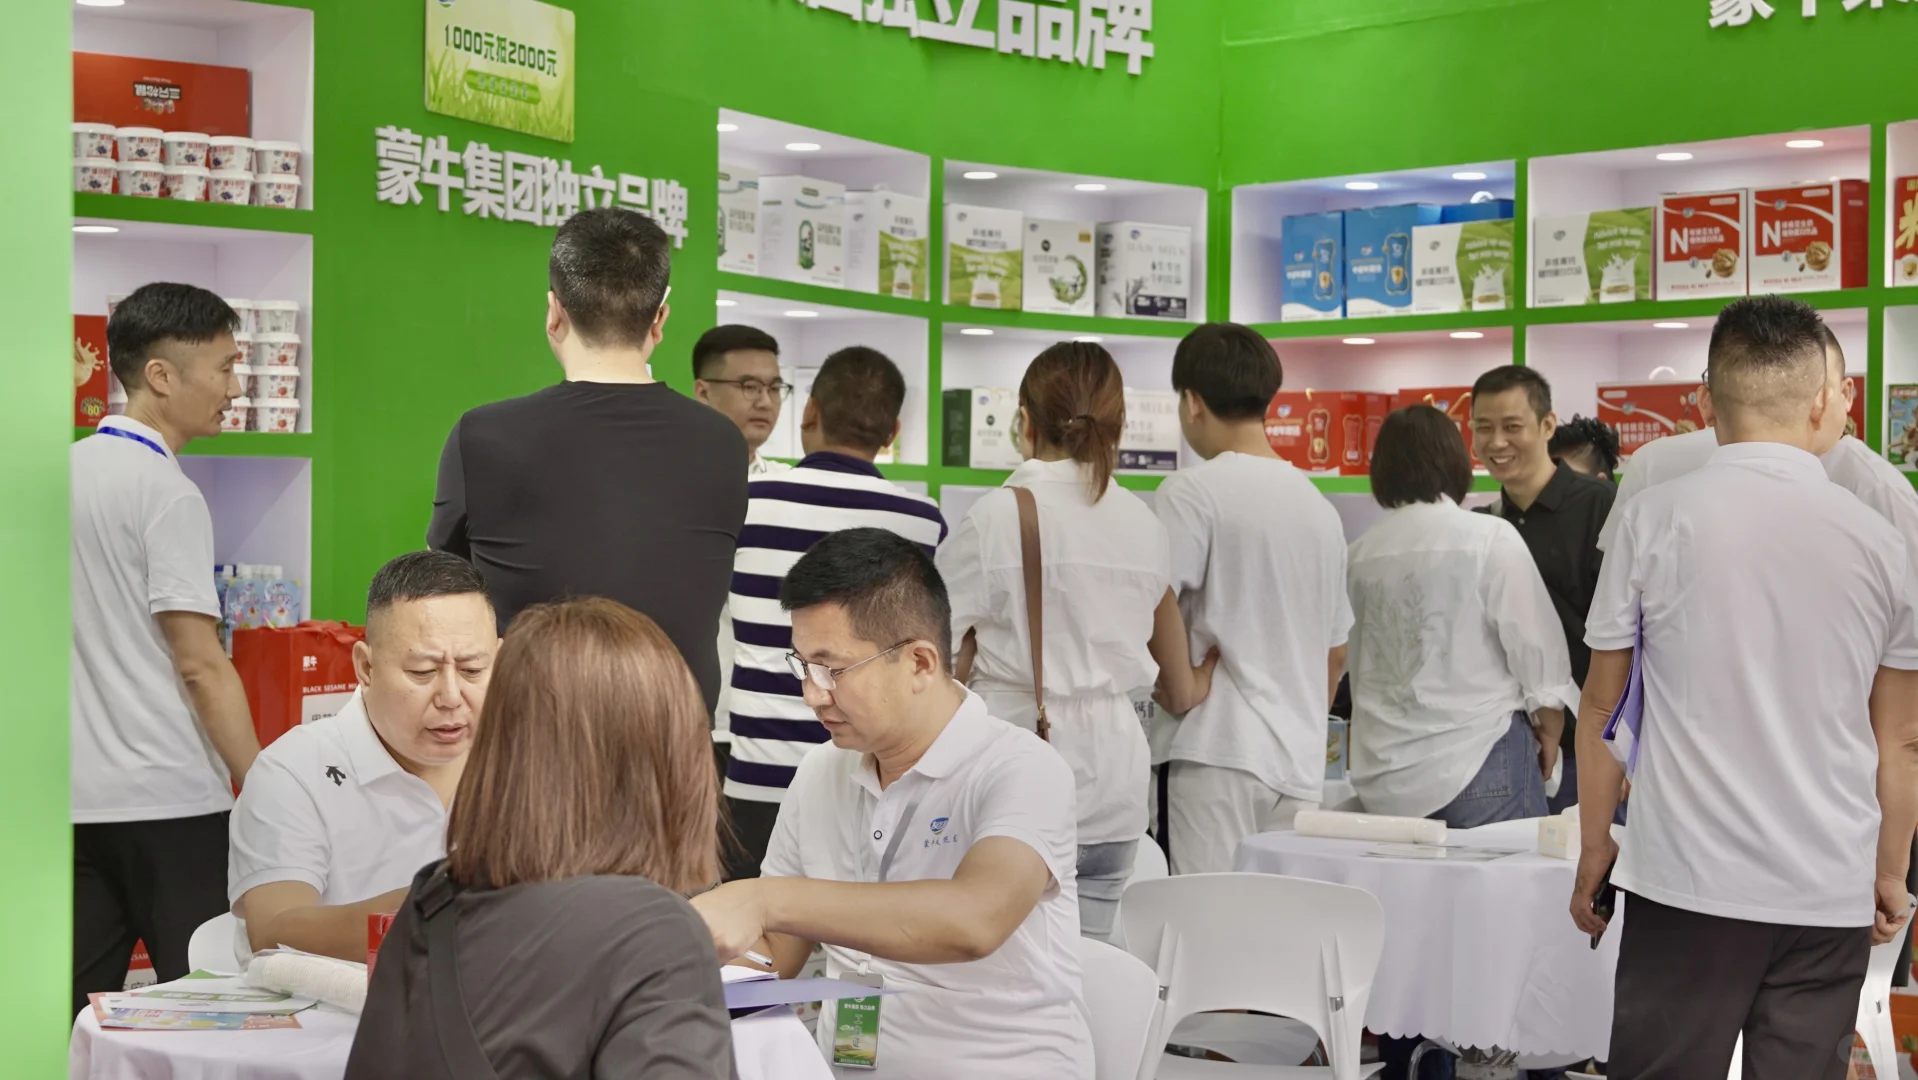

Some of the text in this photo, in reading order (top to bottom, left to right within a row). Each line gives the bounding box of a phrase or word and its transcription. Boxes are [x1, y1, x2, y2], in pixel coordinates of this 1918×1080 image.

[445, 24, 557, 77] 1000元抵2000元
[302, 686, 322, 694] BLACK
[324, 683, 346, 692] SESAME
